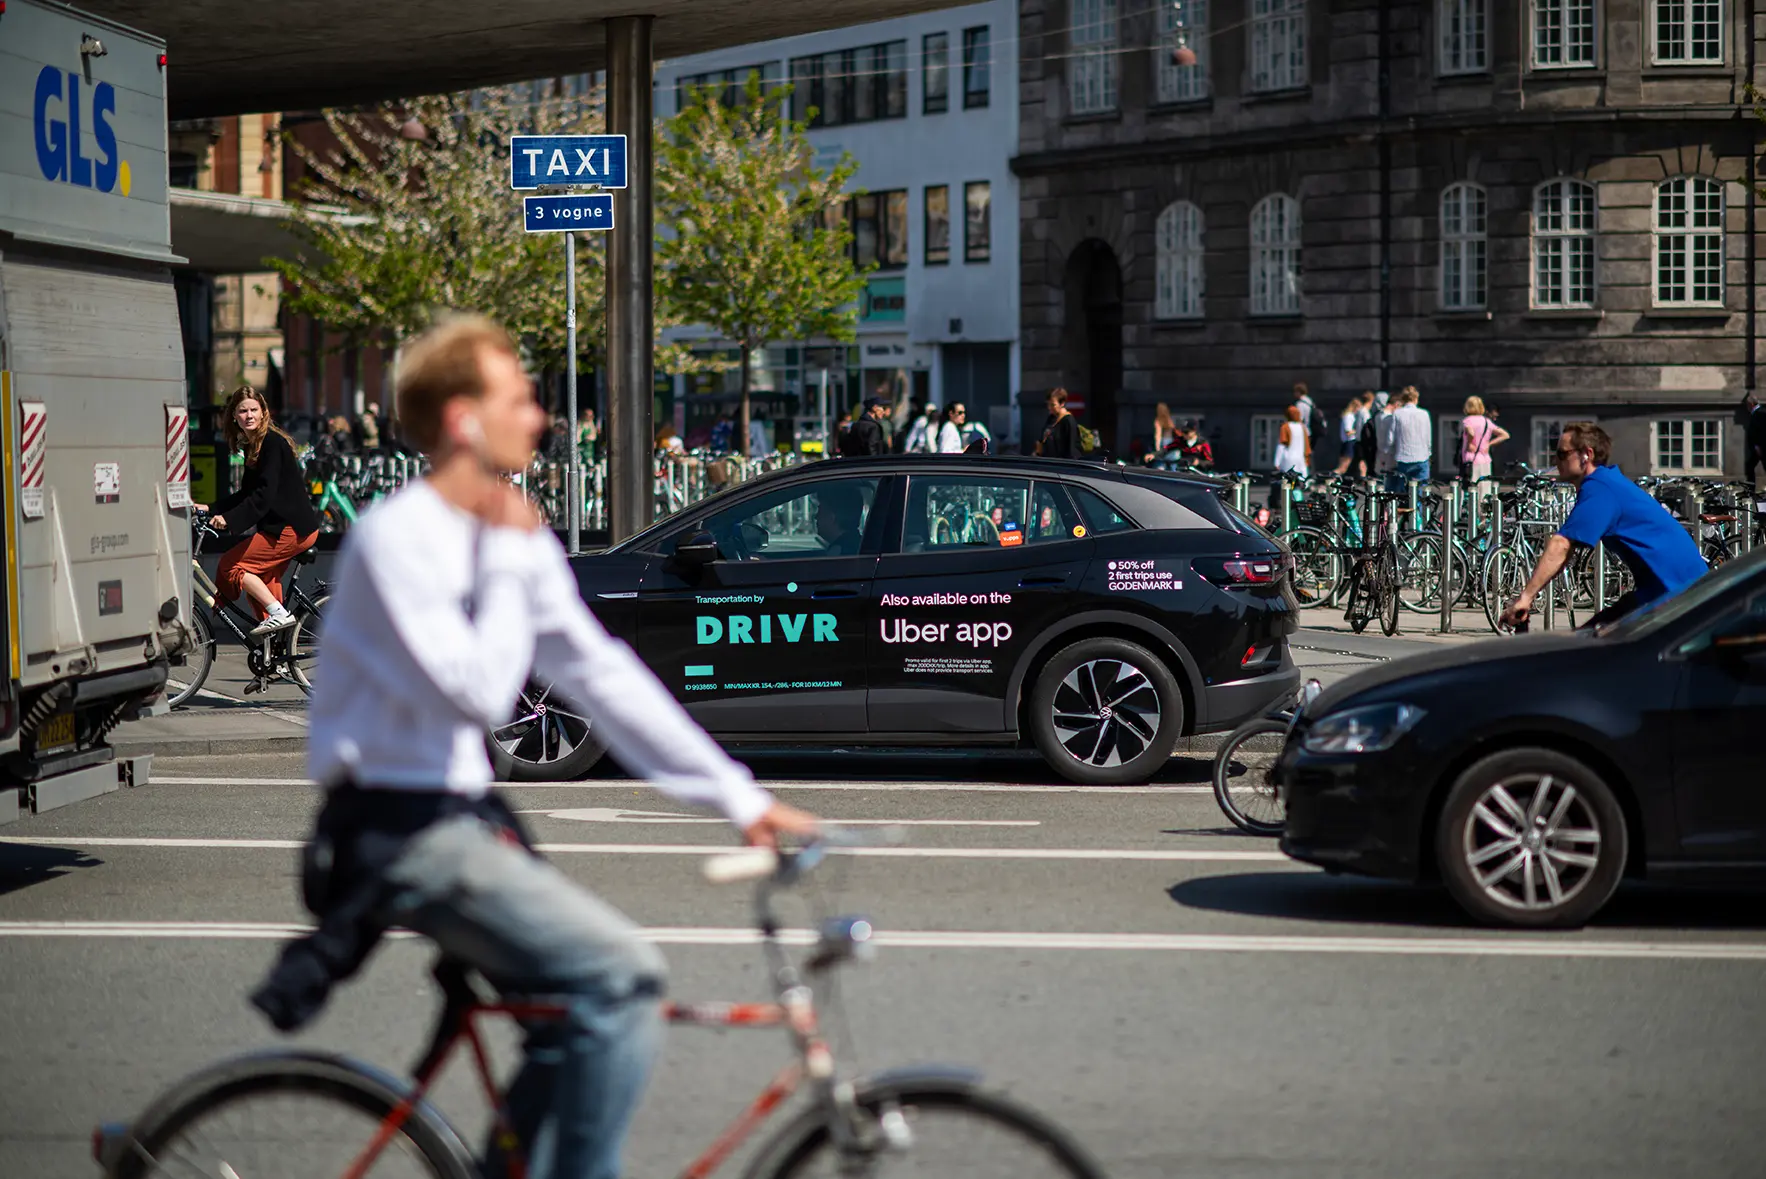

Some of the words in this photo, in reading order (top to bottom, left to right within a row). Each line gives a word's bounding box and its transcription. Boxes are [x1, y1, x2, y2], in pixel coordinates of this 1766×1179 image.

[522, 148, 610, 176] TAXI
[535, 206, 544, 219] 3
[552, 207, 603, 220] vogne
[1118, 561, 1139, 570] 50%
[1141, 561, 1154, 569] off
[1108, 572, 1114, 580] 2
[1116, 571, 1133, 580] first
[1134, 571, 1155, 581] trips
[1108, 581, 1173, 590] GODENMARK
[695, 595, 752, 605] Transportation
[754, 594, 765, 604] by
[880, 594, 910, 606] Also
[912, 593, 968, 605] available
[970, 594, 987, 604] on
[990, 592, 1012, 604] the
[696, 613, 840, 645] DRIVR
[880, 619, 949, 643] Uber
[956, 622, 1013, 648] app
